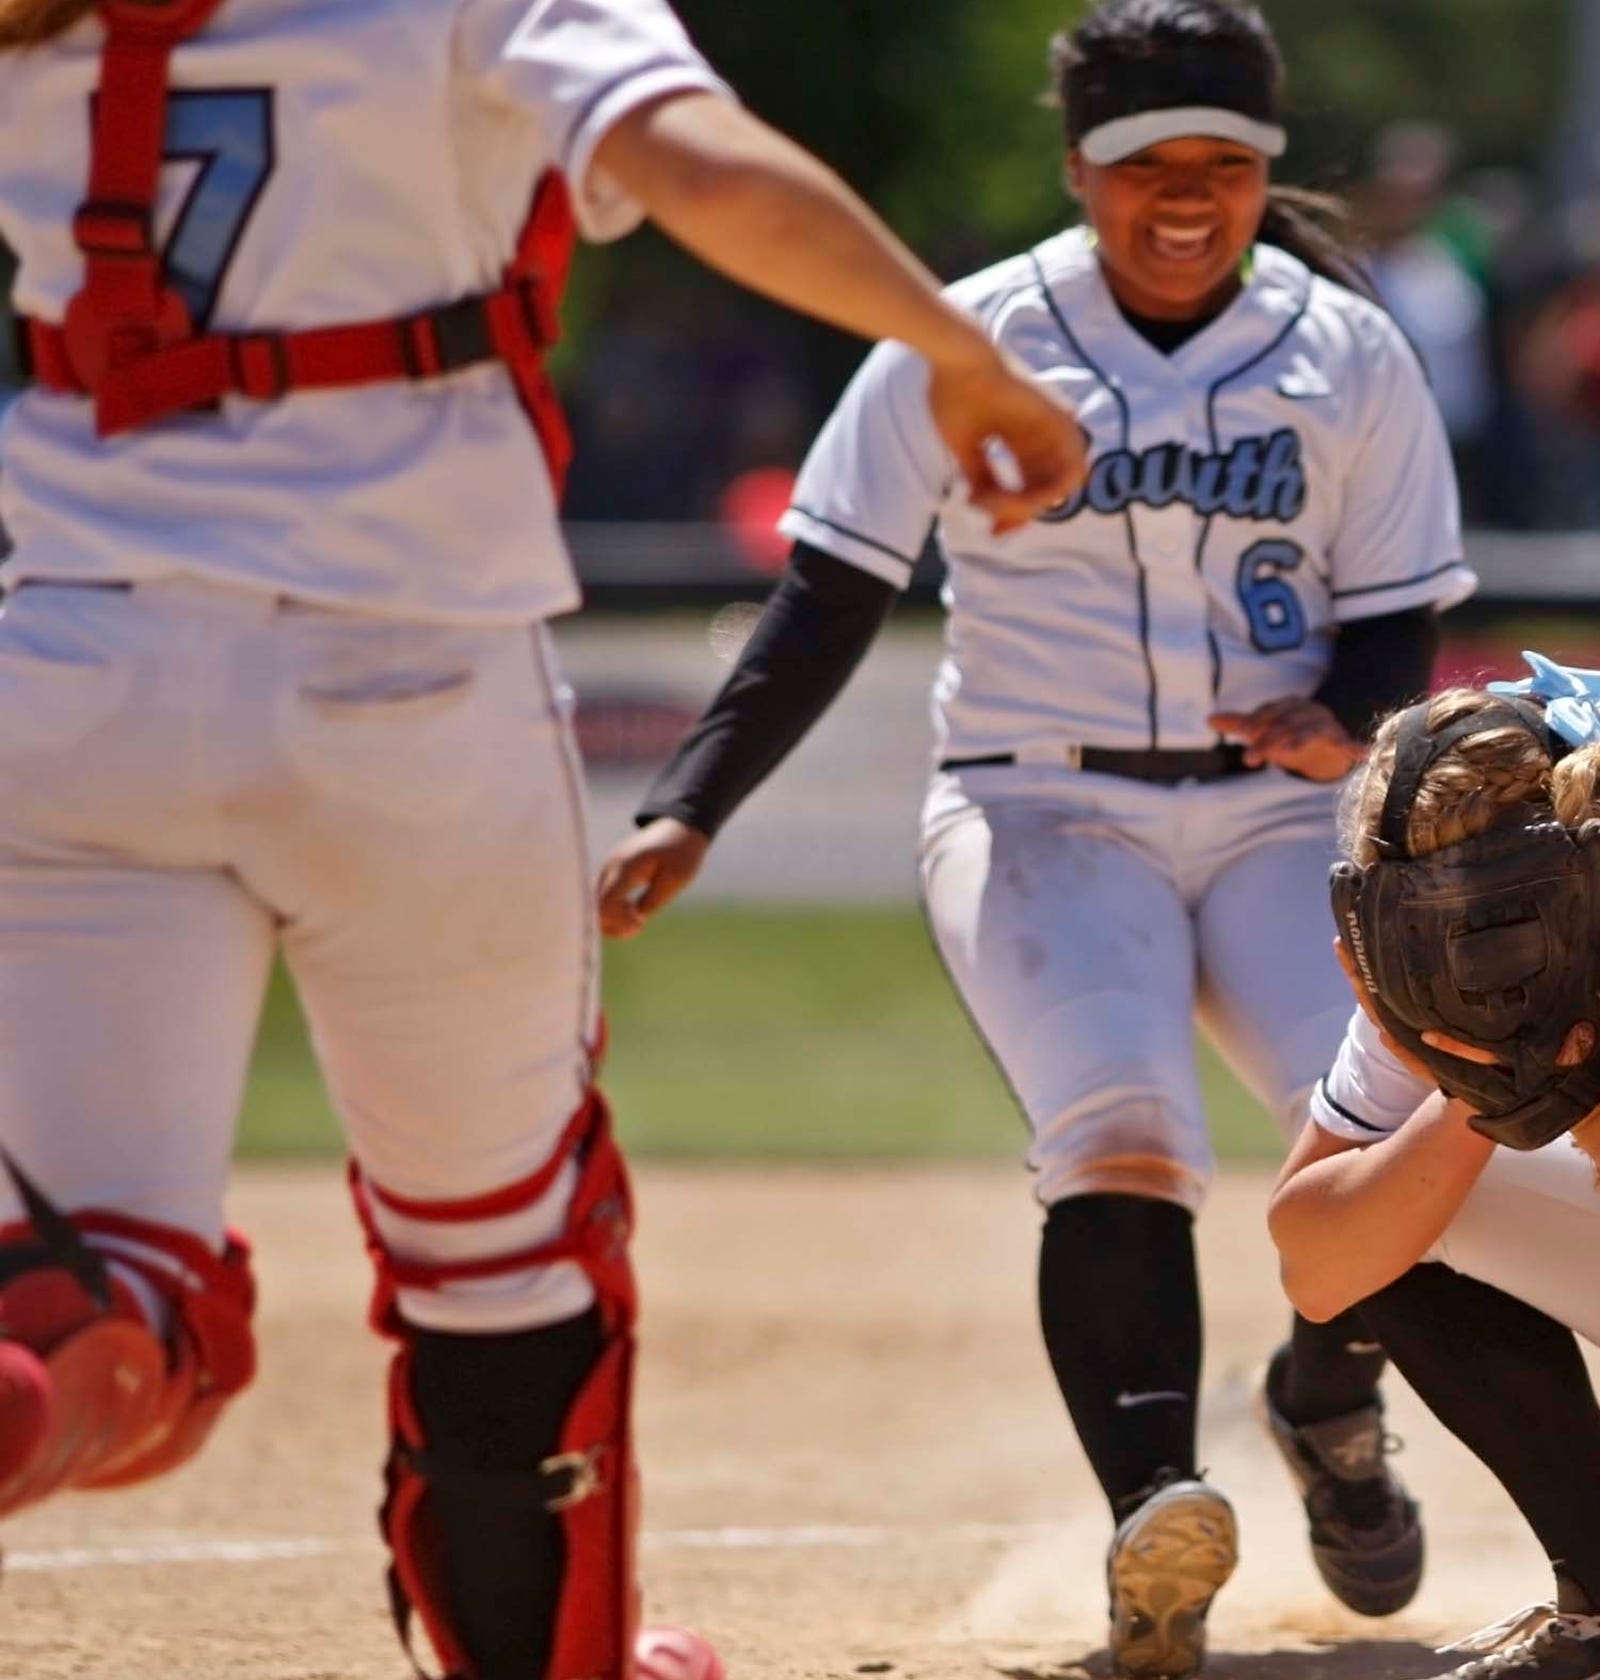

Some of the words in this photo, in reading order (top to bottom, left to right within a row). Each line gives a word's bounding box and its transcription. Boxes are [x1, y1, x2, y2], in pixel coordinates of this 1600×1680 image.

[90, 87, 275, 337] 7
[1037, 427, 1305, 522] outh
[1236, 538, 1304, 653] 6
